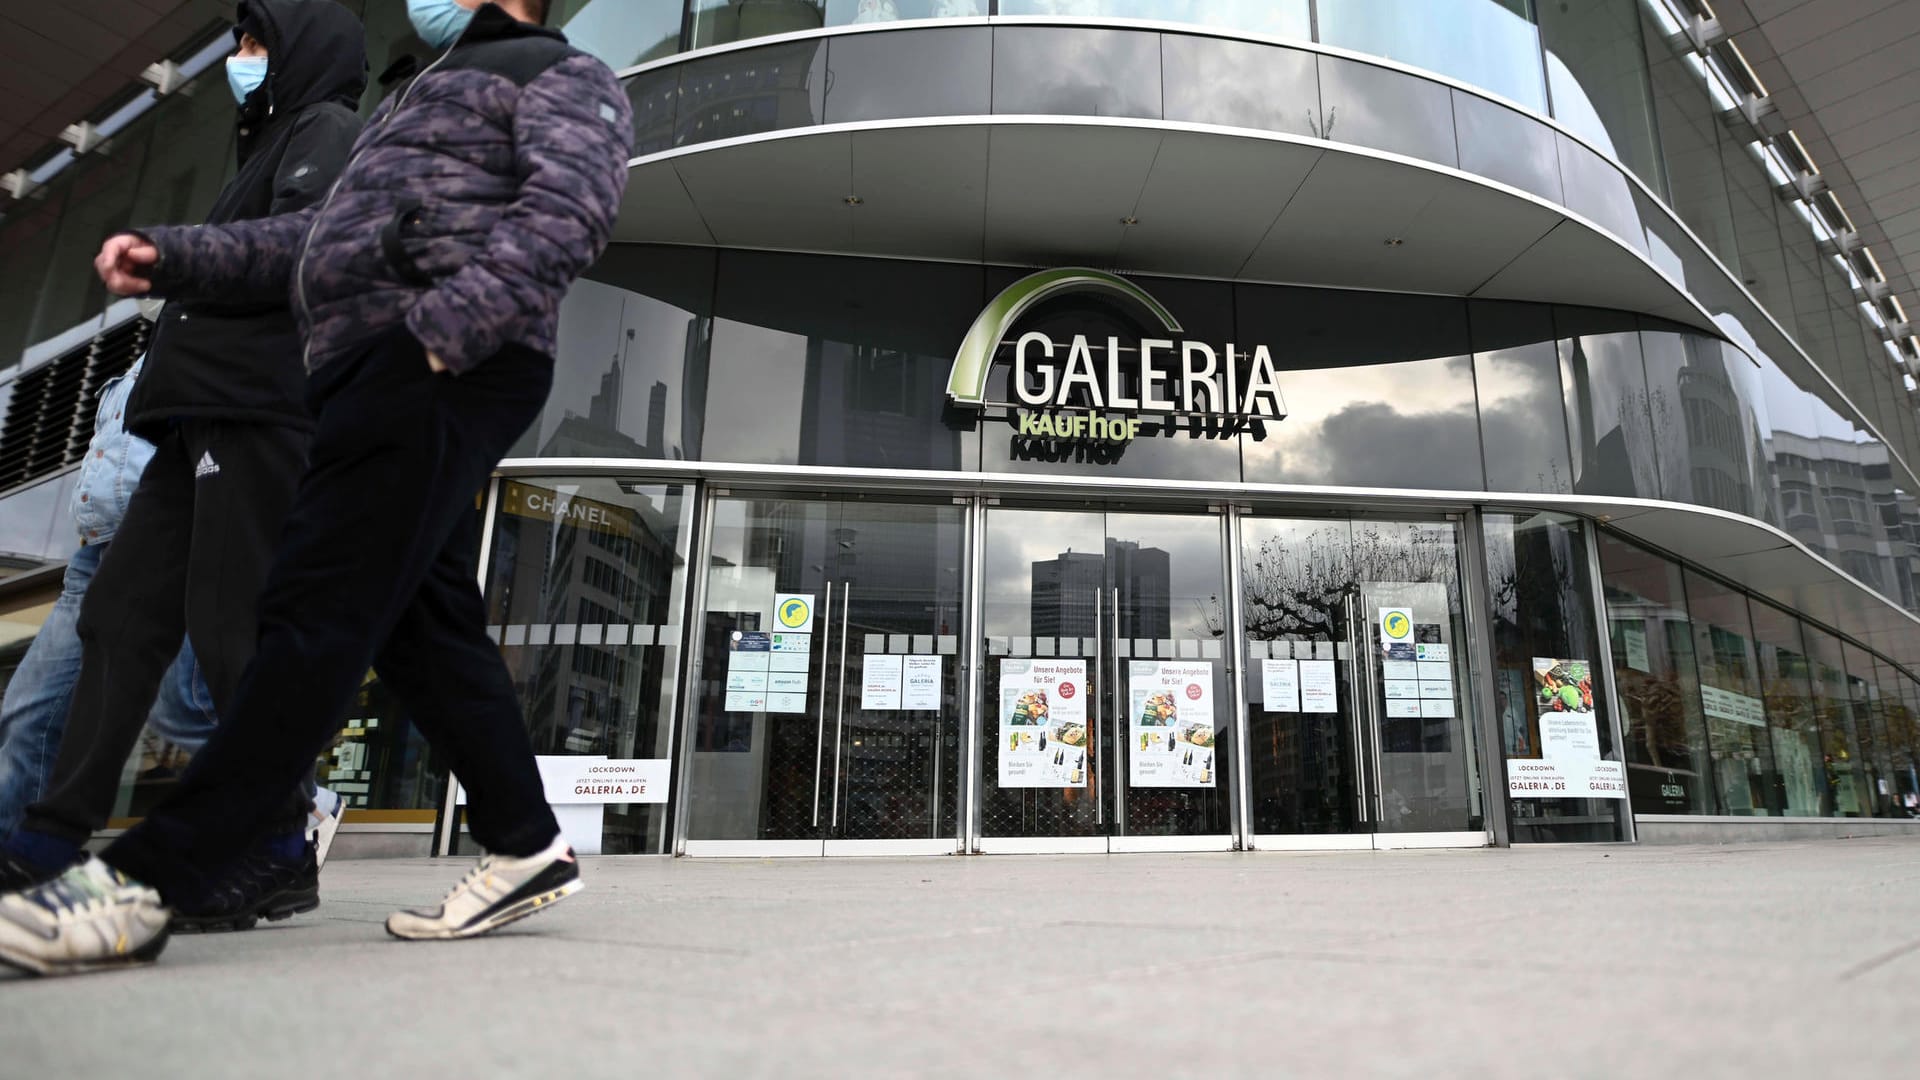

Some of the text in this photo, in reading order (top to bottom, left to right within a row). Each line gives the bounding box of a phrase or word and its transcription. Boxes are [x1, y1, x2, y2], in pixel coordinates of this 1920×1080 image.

[1014, 331, 1288, 420] GALERIA
[527, 493, 611, 526] CHANEL
[1033, 665, 1055, 674] Unsere
[1055, 665, 1083, 675] Angebote
[1033, 675, 1043, 684] für
